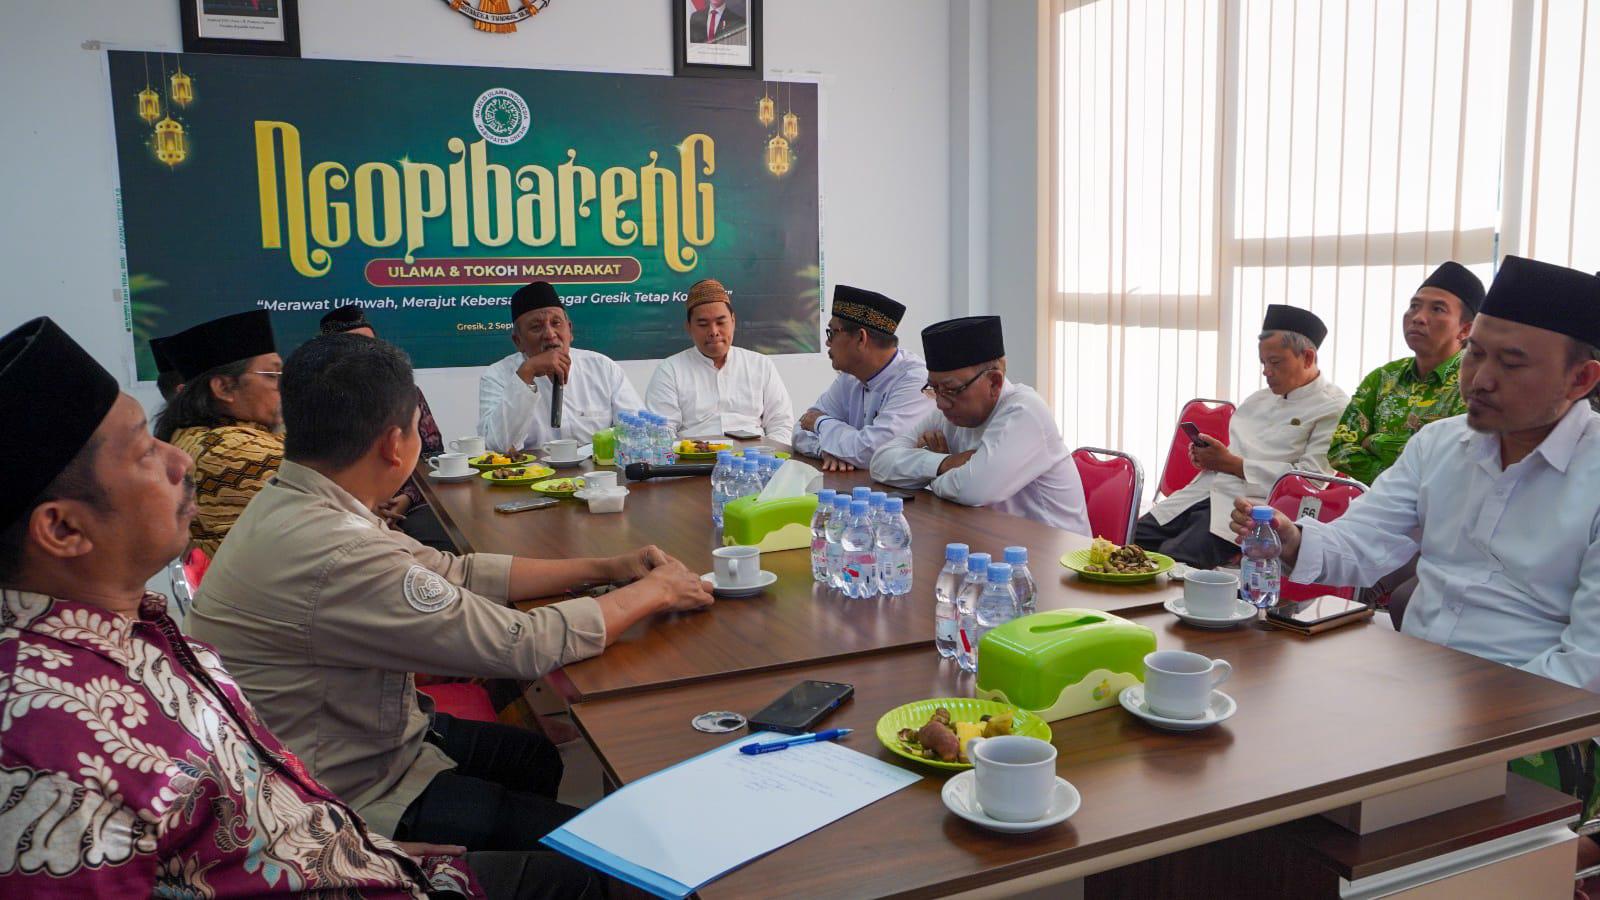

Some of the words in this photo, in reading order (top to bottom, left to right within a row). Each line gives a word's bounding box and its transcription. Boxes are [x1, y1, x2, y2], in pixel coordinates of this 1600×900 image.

[488, 90, 508, 98] ULAMA
[387, 266, 446, 278] ULAMA
[449, 265, 461, 277] &
[464, 265, 518, 277] TOKOH
[522, 263, 622, 276] MASYARAKAT
[402, 295, 457, 308] Merajut
[590, 292, 631, 304] Gresik
[634, 292, 670, 305] Tetap
[456, 322, 487, 331] Gresik,
[488, 322, 494, 330] 2
[1301, 507, 1316, 519] 56
